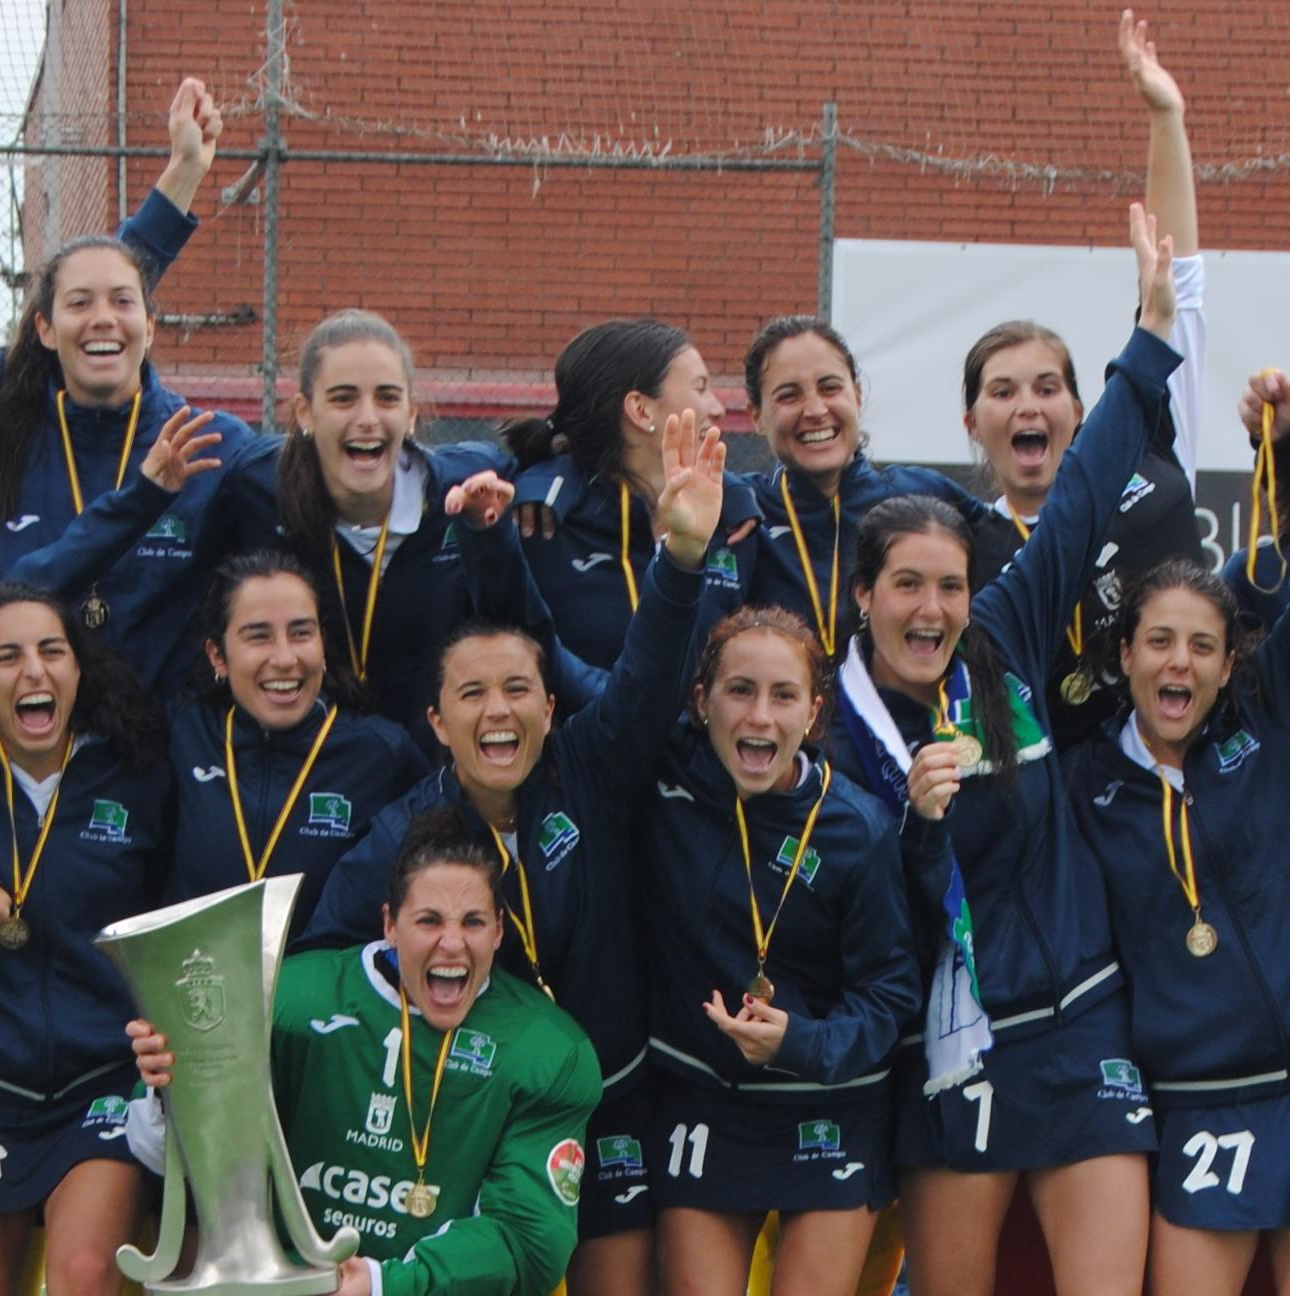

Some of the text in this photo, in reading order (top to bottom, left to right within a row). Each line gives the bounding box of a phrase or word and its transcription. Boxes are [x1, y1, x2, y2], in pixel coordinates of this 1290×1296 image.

[156, 548, 166, 556] de
[963, 1081, 994, 1153] 7
[346, 1129, 404, 1152] MADRID
[667, 1122, 709, 1178] 11
[811, 1152, 819, 1160] de
[1182, 1130, 1255, 1195] 27
[323, 1207, 397, 1239] seguros
